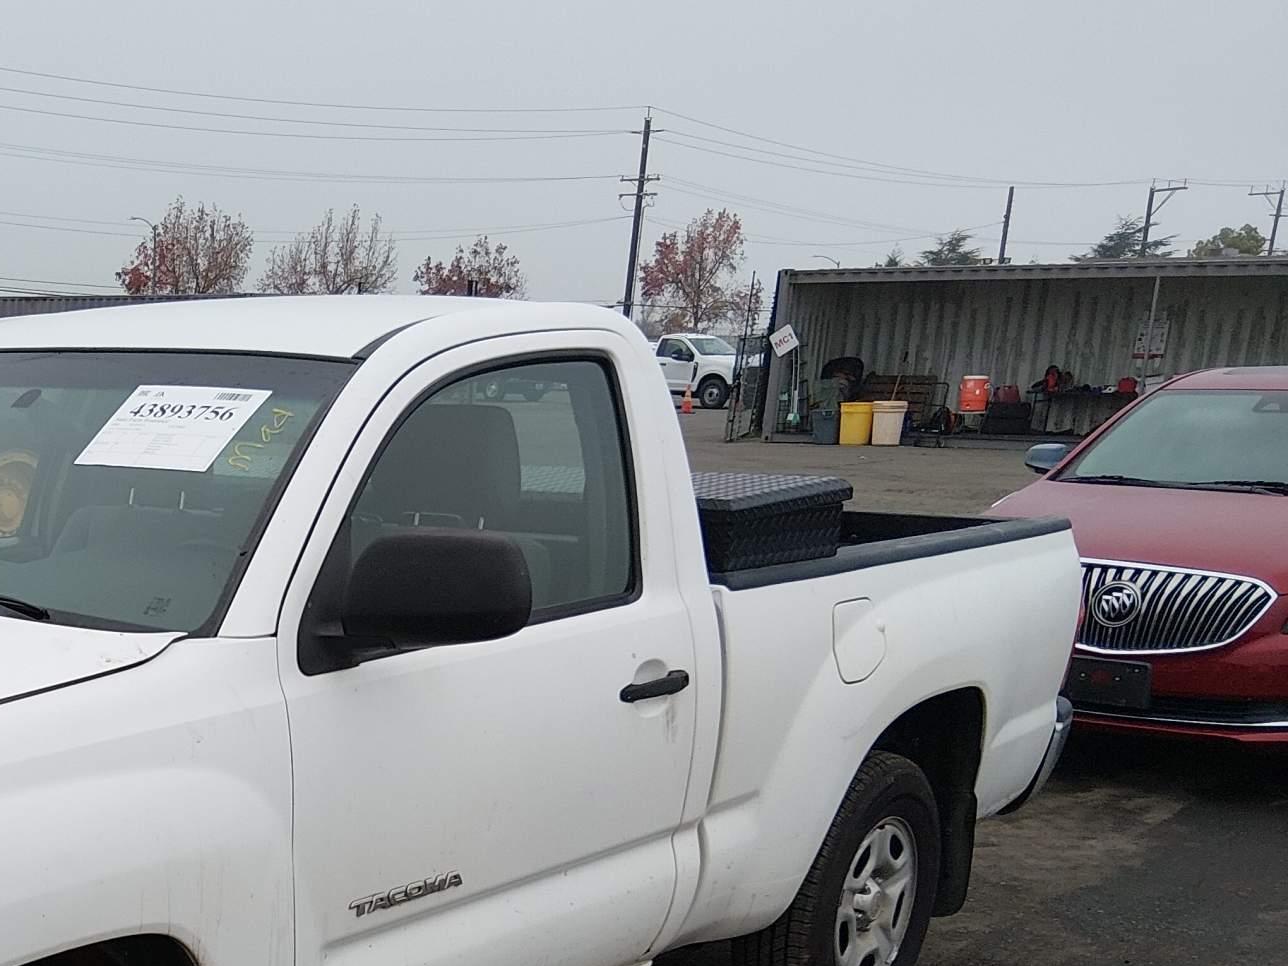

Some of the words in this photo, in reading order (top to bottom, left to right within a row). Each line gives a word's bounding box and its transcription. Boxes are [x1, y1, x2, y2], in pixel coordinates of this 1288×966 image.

[774, 332, 794, 349] MC1
[129, 402, 240, 422] 43893756
[348, 869, 463, 918] TACOMA
